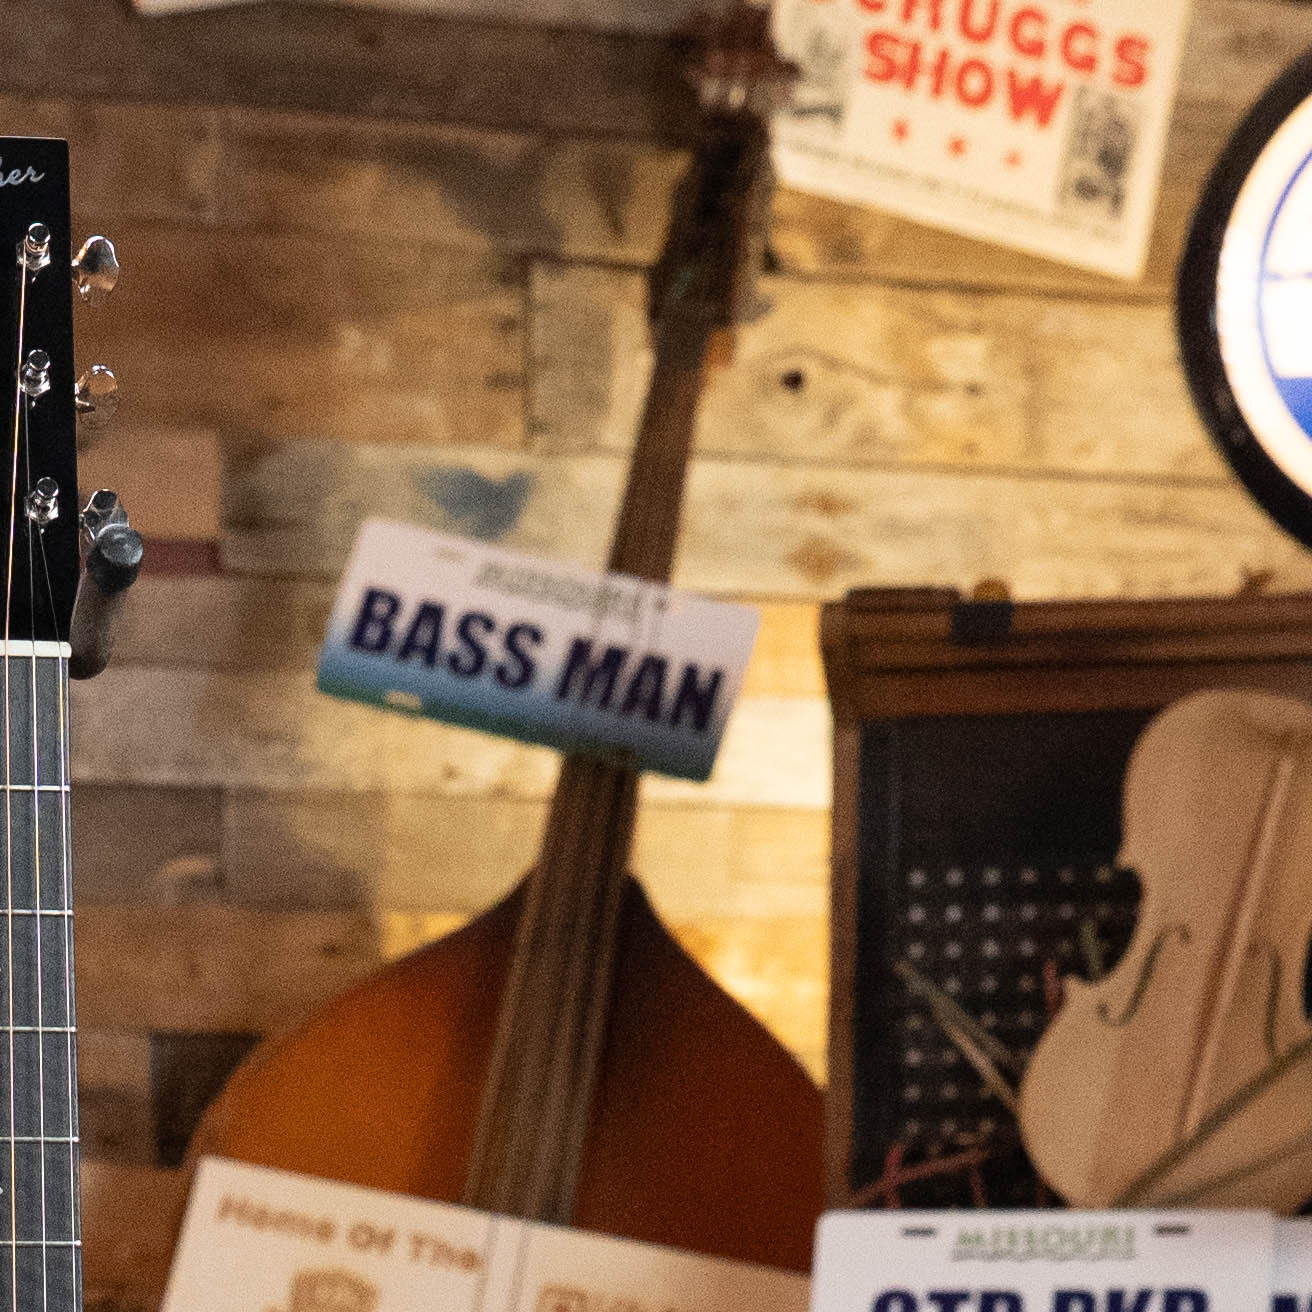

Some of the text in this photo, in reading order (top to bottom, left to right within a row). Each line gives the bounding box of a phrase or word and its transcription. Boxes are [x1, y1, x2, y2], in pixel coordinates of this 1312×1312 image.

[854, 0, 1151, 88] UGGS
[863, 29, 1064, 129] SHOW
[347, 587, 545, 690] BASS
[555, 635, 726, 733] MAN
[346, 1217, 397, 1257] Of
[407, 1227, 484, 1275] The
